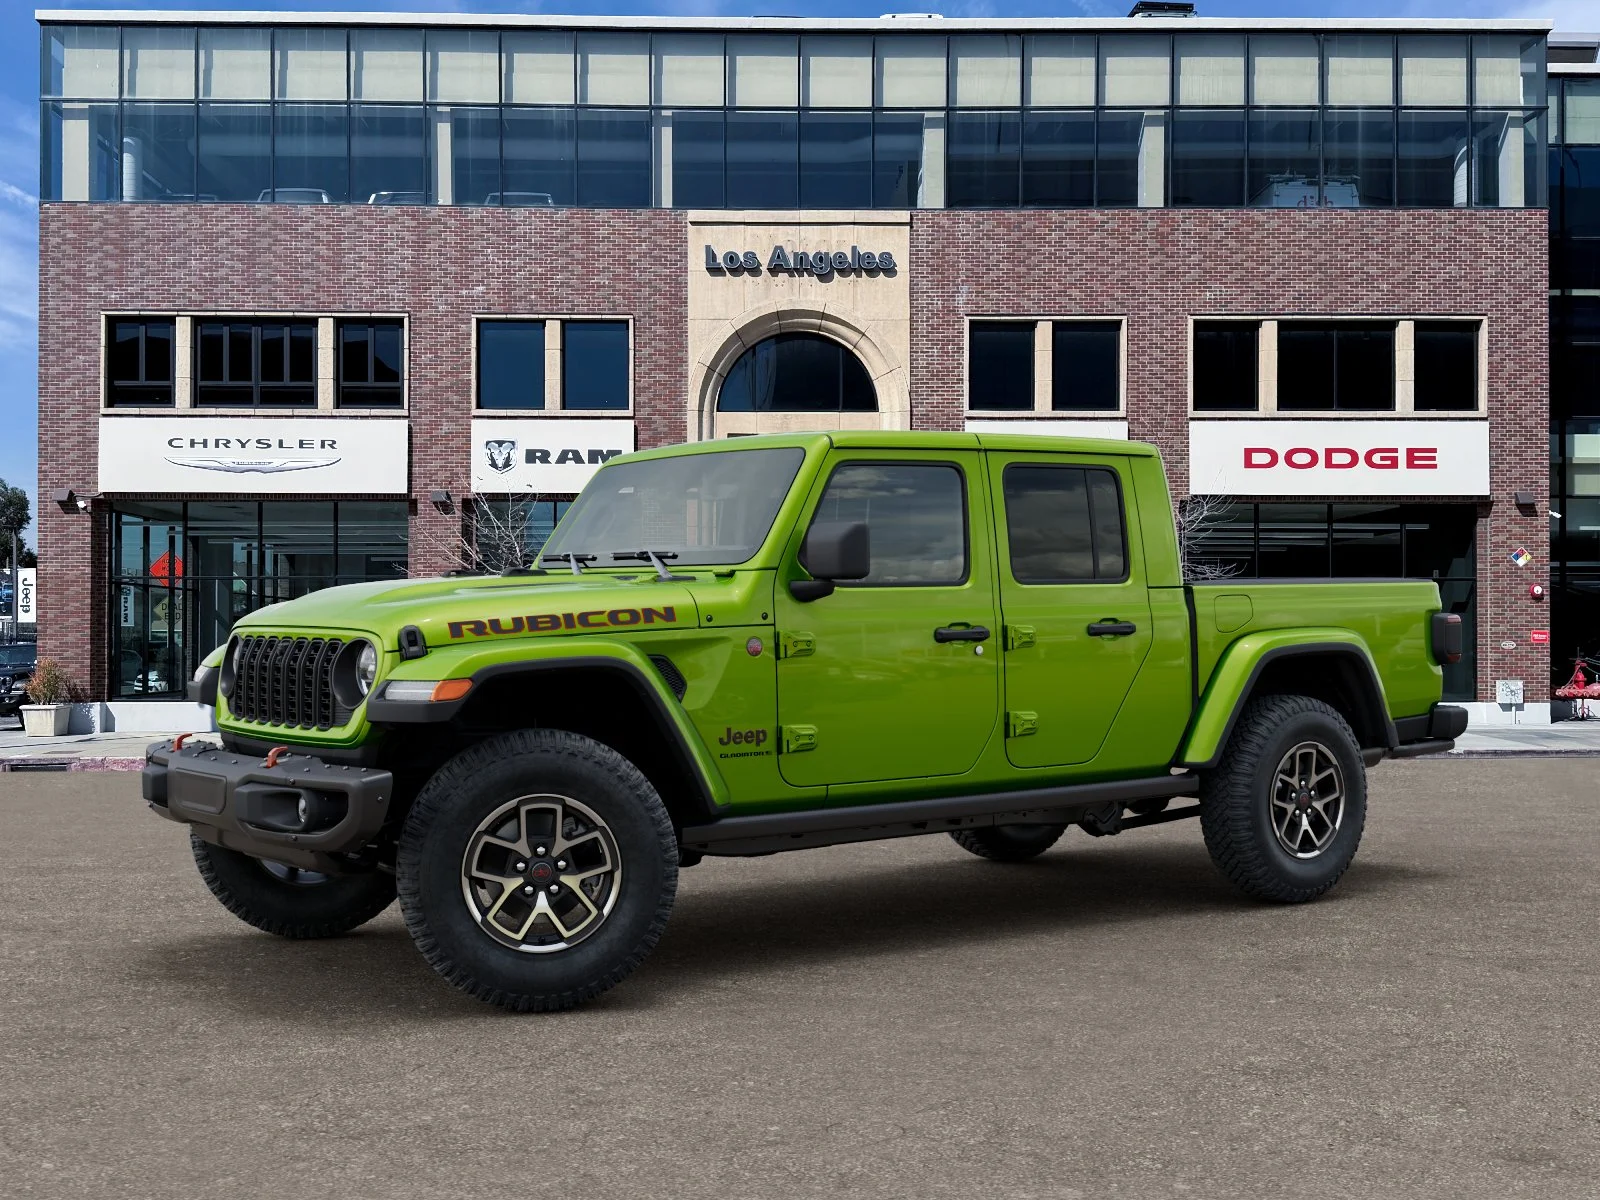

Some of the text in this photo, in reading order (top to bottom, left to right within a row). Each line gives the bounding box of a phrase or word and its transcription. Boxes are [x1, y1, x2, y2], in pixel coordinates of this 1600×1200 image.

[705, 244, 895, 275] Los Angeles
[168, 437, 338, 449] CHRYSLER
[1243, 447, 1438, 470] DODGE
[20, 577, 33, 613] Jeep
[447, 606, 677, 639] RUBICON
[718, 727, 768, 747] Jeep
[720, 751, 764, 759] GLADIATOR
